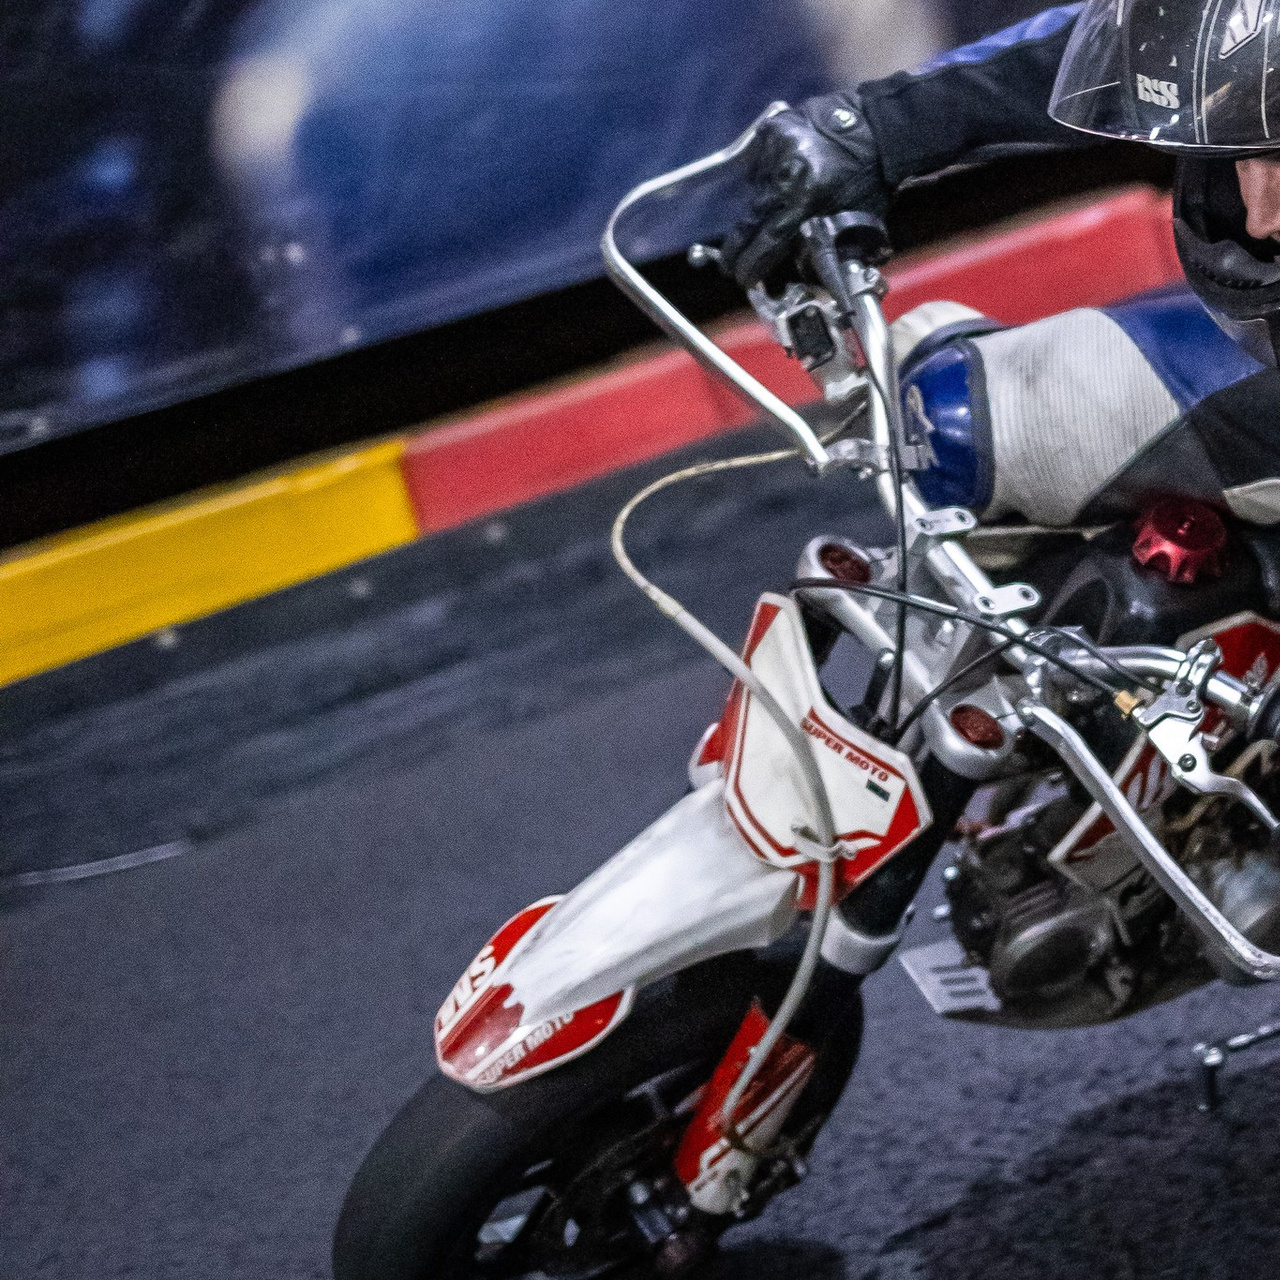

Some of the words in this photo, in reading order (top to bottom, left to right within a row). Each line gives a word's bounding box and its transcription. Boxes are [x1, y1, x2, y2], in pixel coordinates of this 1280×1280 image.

[801, 717, 844, 754] SUPER
[845, 752, 888, 782] MOTO
[478, 1039, 529, 1083] SUPER
[526, 1011, 577, 1052] MOTO
